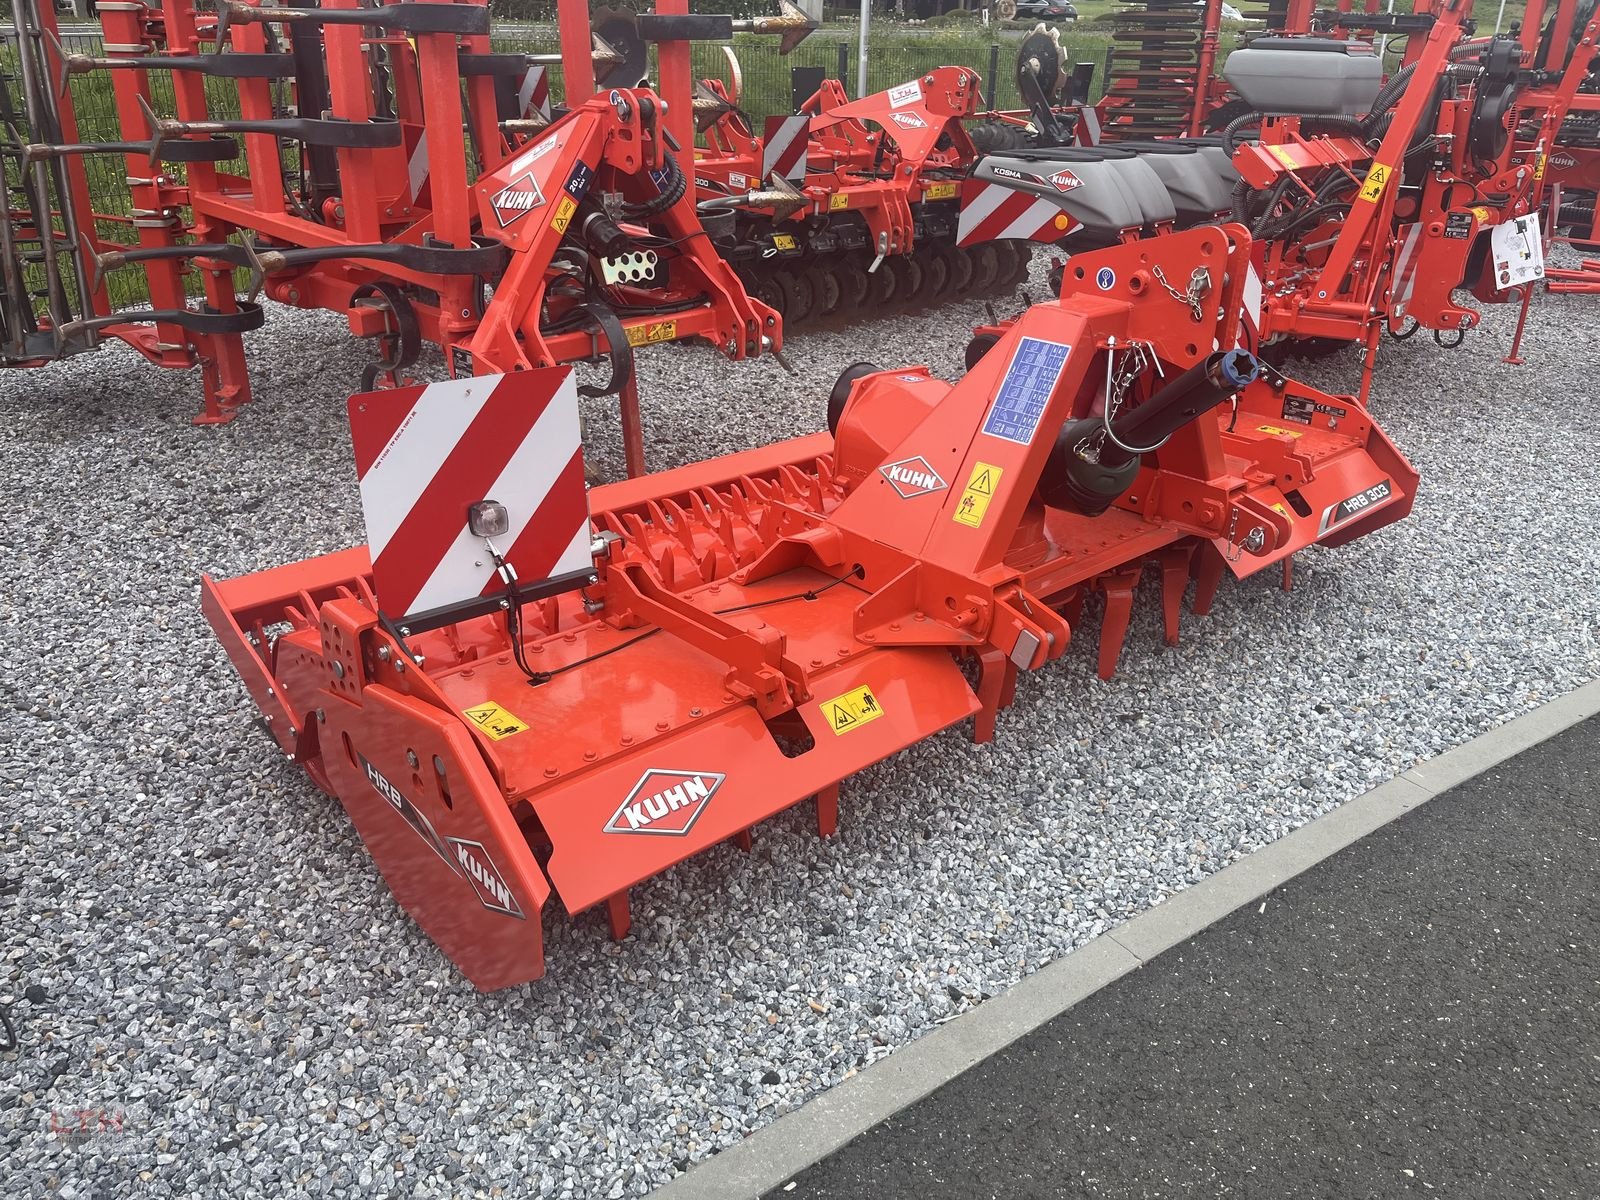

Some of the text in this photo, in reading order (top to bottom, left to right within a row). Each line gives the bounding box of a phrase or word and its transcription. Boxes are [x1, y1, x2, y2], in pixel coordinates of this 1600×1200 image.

[894, 113, 922, 127] KUHN
[1548, 157, 1575, 167] KUHN
[993, 167, 1021, 179] KOSMA
[1052, 175, 1079, 187] KUHN
[569, 180, 578, 193] 20
[578, 178, 586, 189] MAX
[496, 190, 538, 210] KUHN
[888, 465, 937, 490] KUHN
[1342, 483, 1390, 513] HRB 303
[367, 763, 402, 809] HRB
[623, 775, 710, 830] KUHN
[457, 843, 511, 912] KUHN
